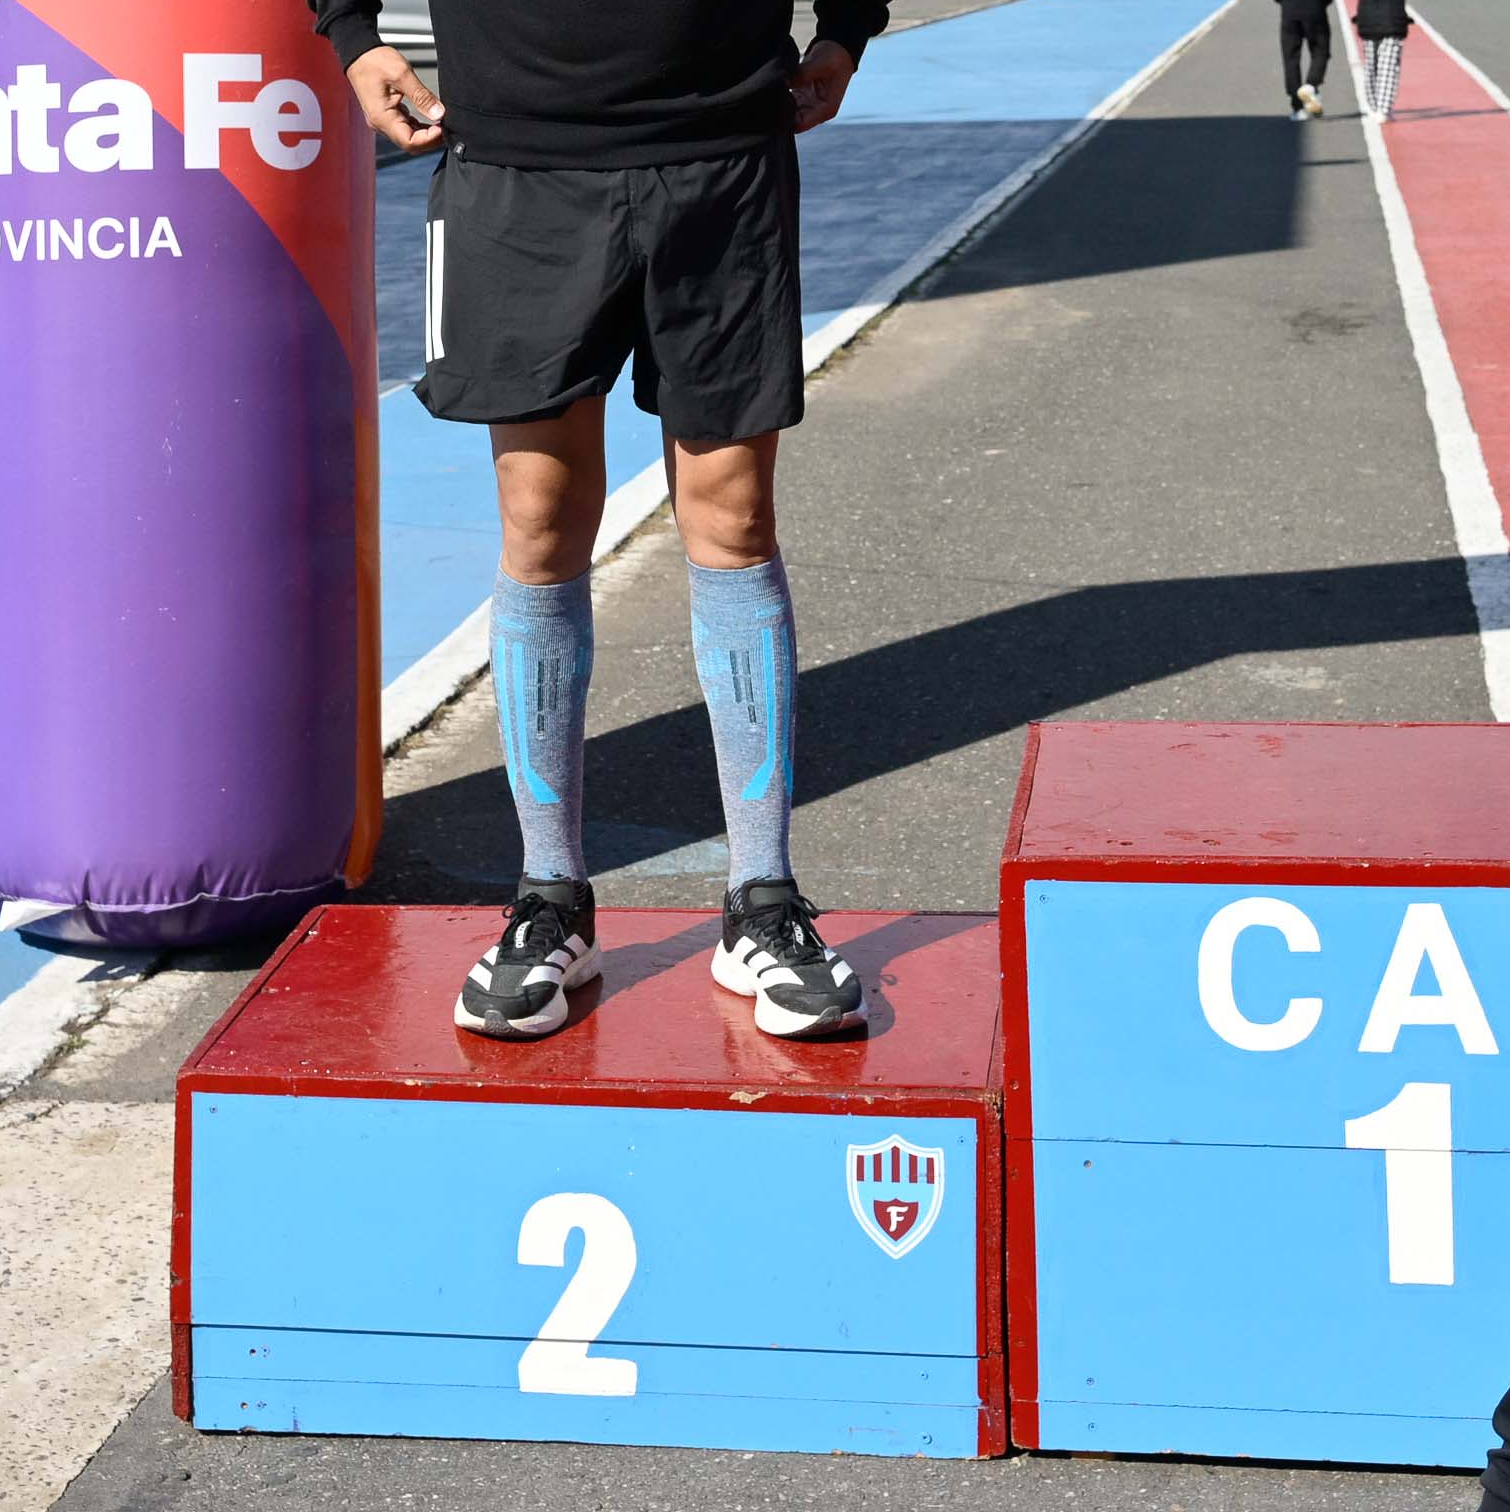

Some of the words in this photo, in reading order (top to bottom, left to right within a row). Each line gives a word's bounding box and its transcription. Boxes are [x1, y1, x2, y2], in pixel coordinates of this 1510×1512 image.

[183, 53, 322, 171] Fe
[885, 1205, 909, 1234] F
[1343, 1081, 1456, 1287] 1
[517, 1191, 638, 1397] 2
